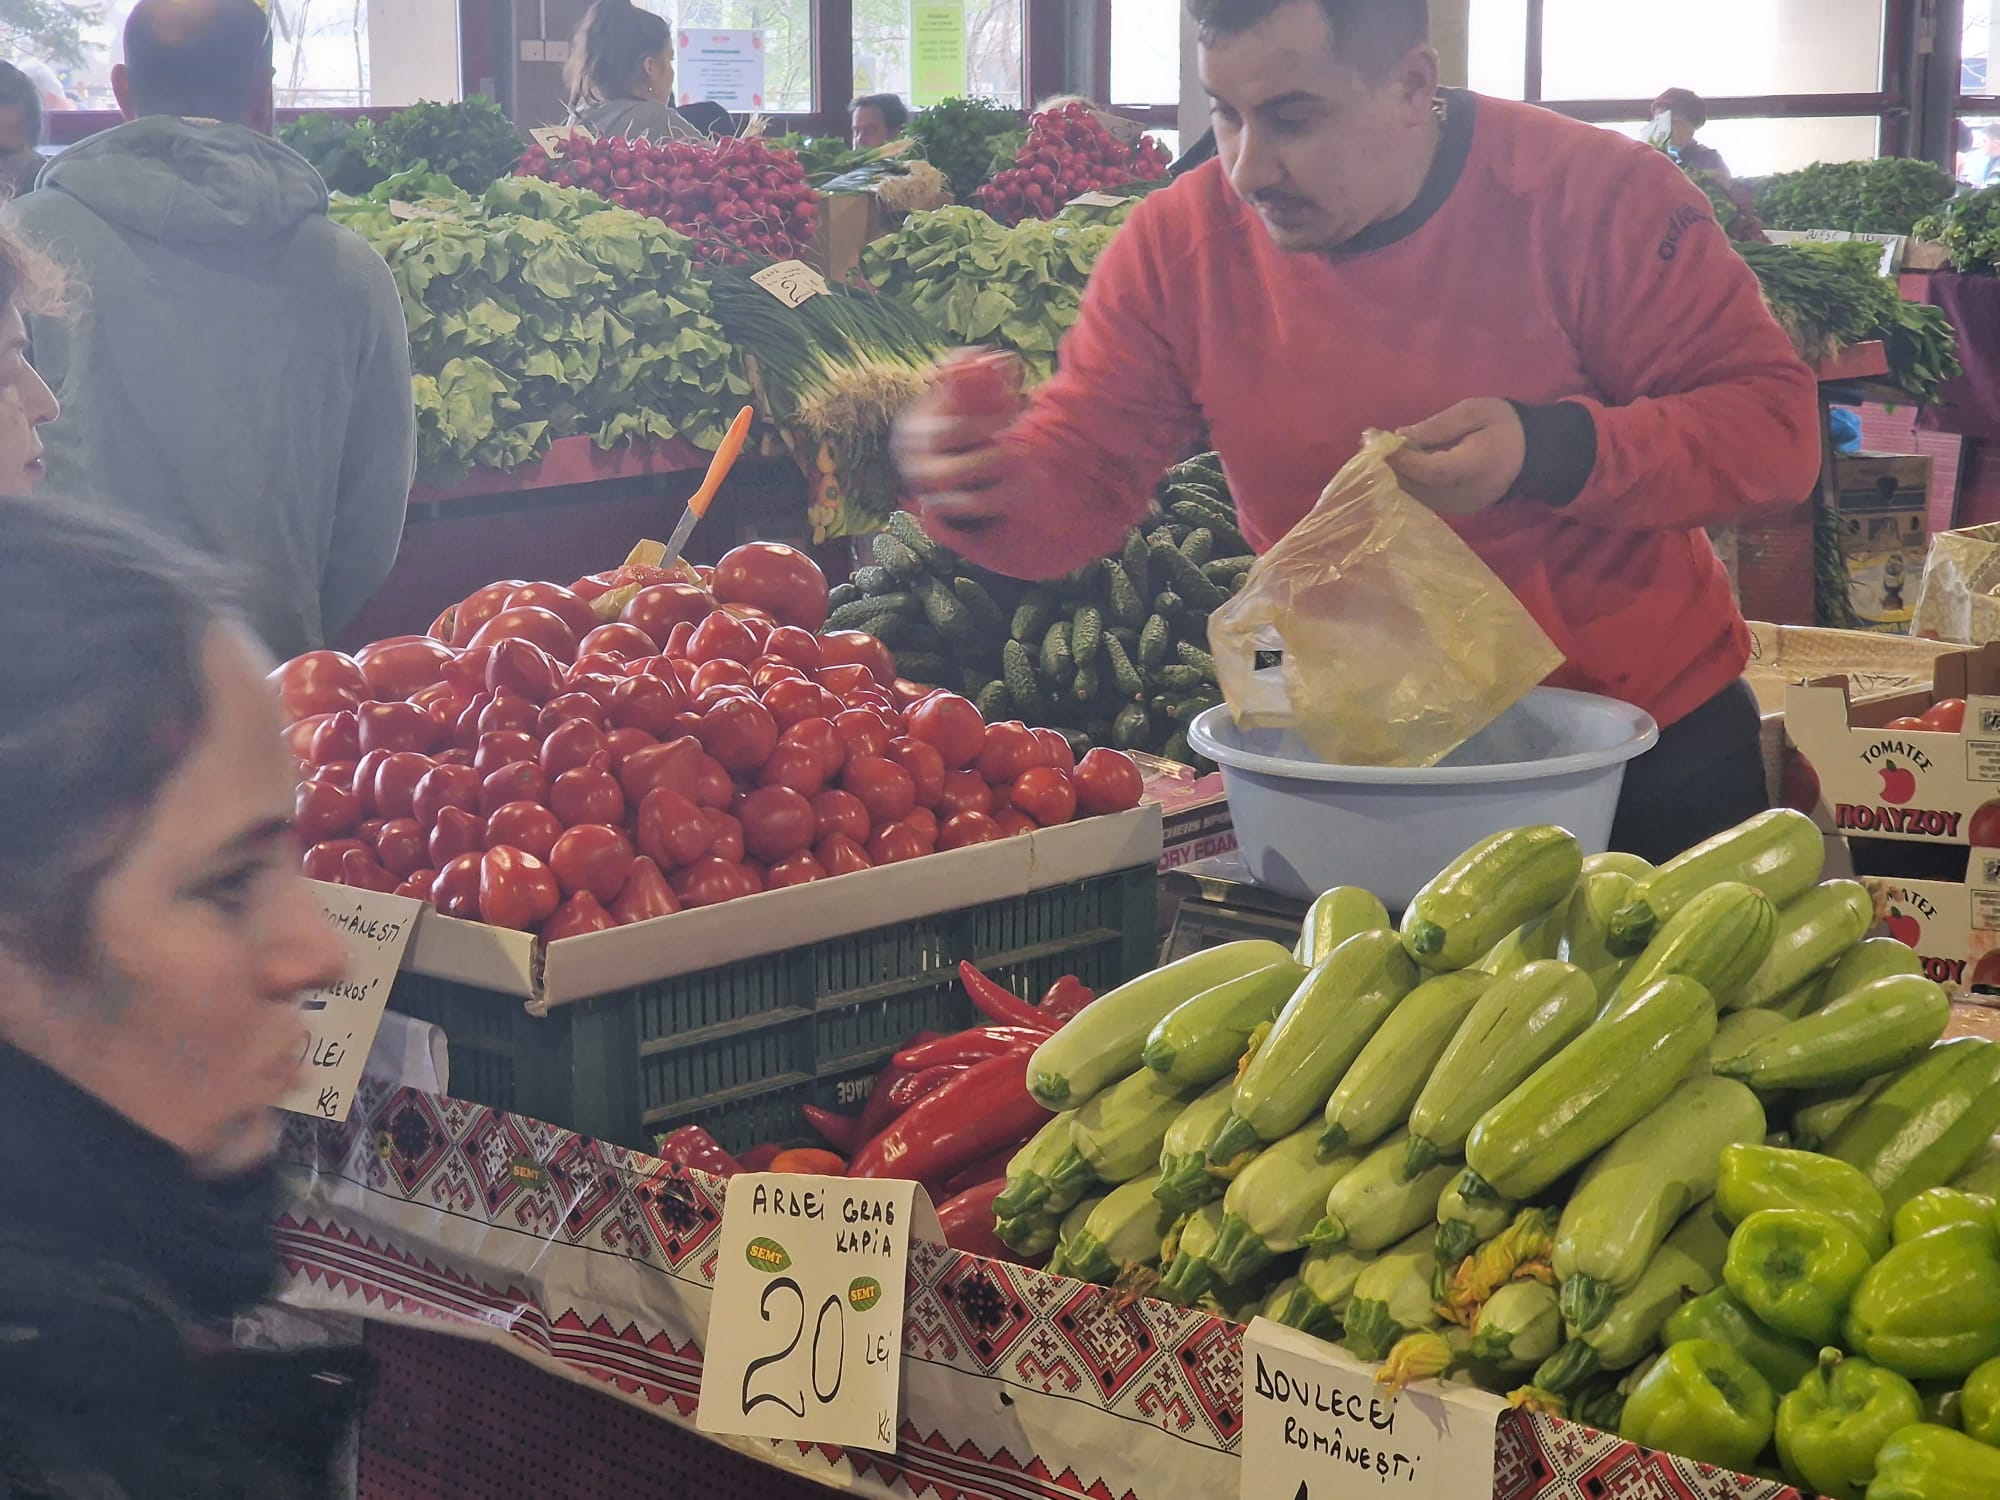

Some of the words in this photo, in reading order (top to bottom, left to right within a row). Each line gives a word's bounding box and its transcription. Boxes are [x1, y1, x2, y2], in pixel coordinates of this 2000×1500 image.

[1860, 739, 1934, 773] ΤΟΜΑΤΕΣ
[1835, 803, 1963, 838] ΠΟΛΥΖΟΥ
[316, 1085, 340, 1117] KG
[513, 1165, 540, 1180] SEMT
[749, 1245, 784, 1265] SEMT
[850, 1286, 876, 1302] SEMT
[741, 1276, 845, 1419] 20
[877, 1409, 891, 1444] KG
